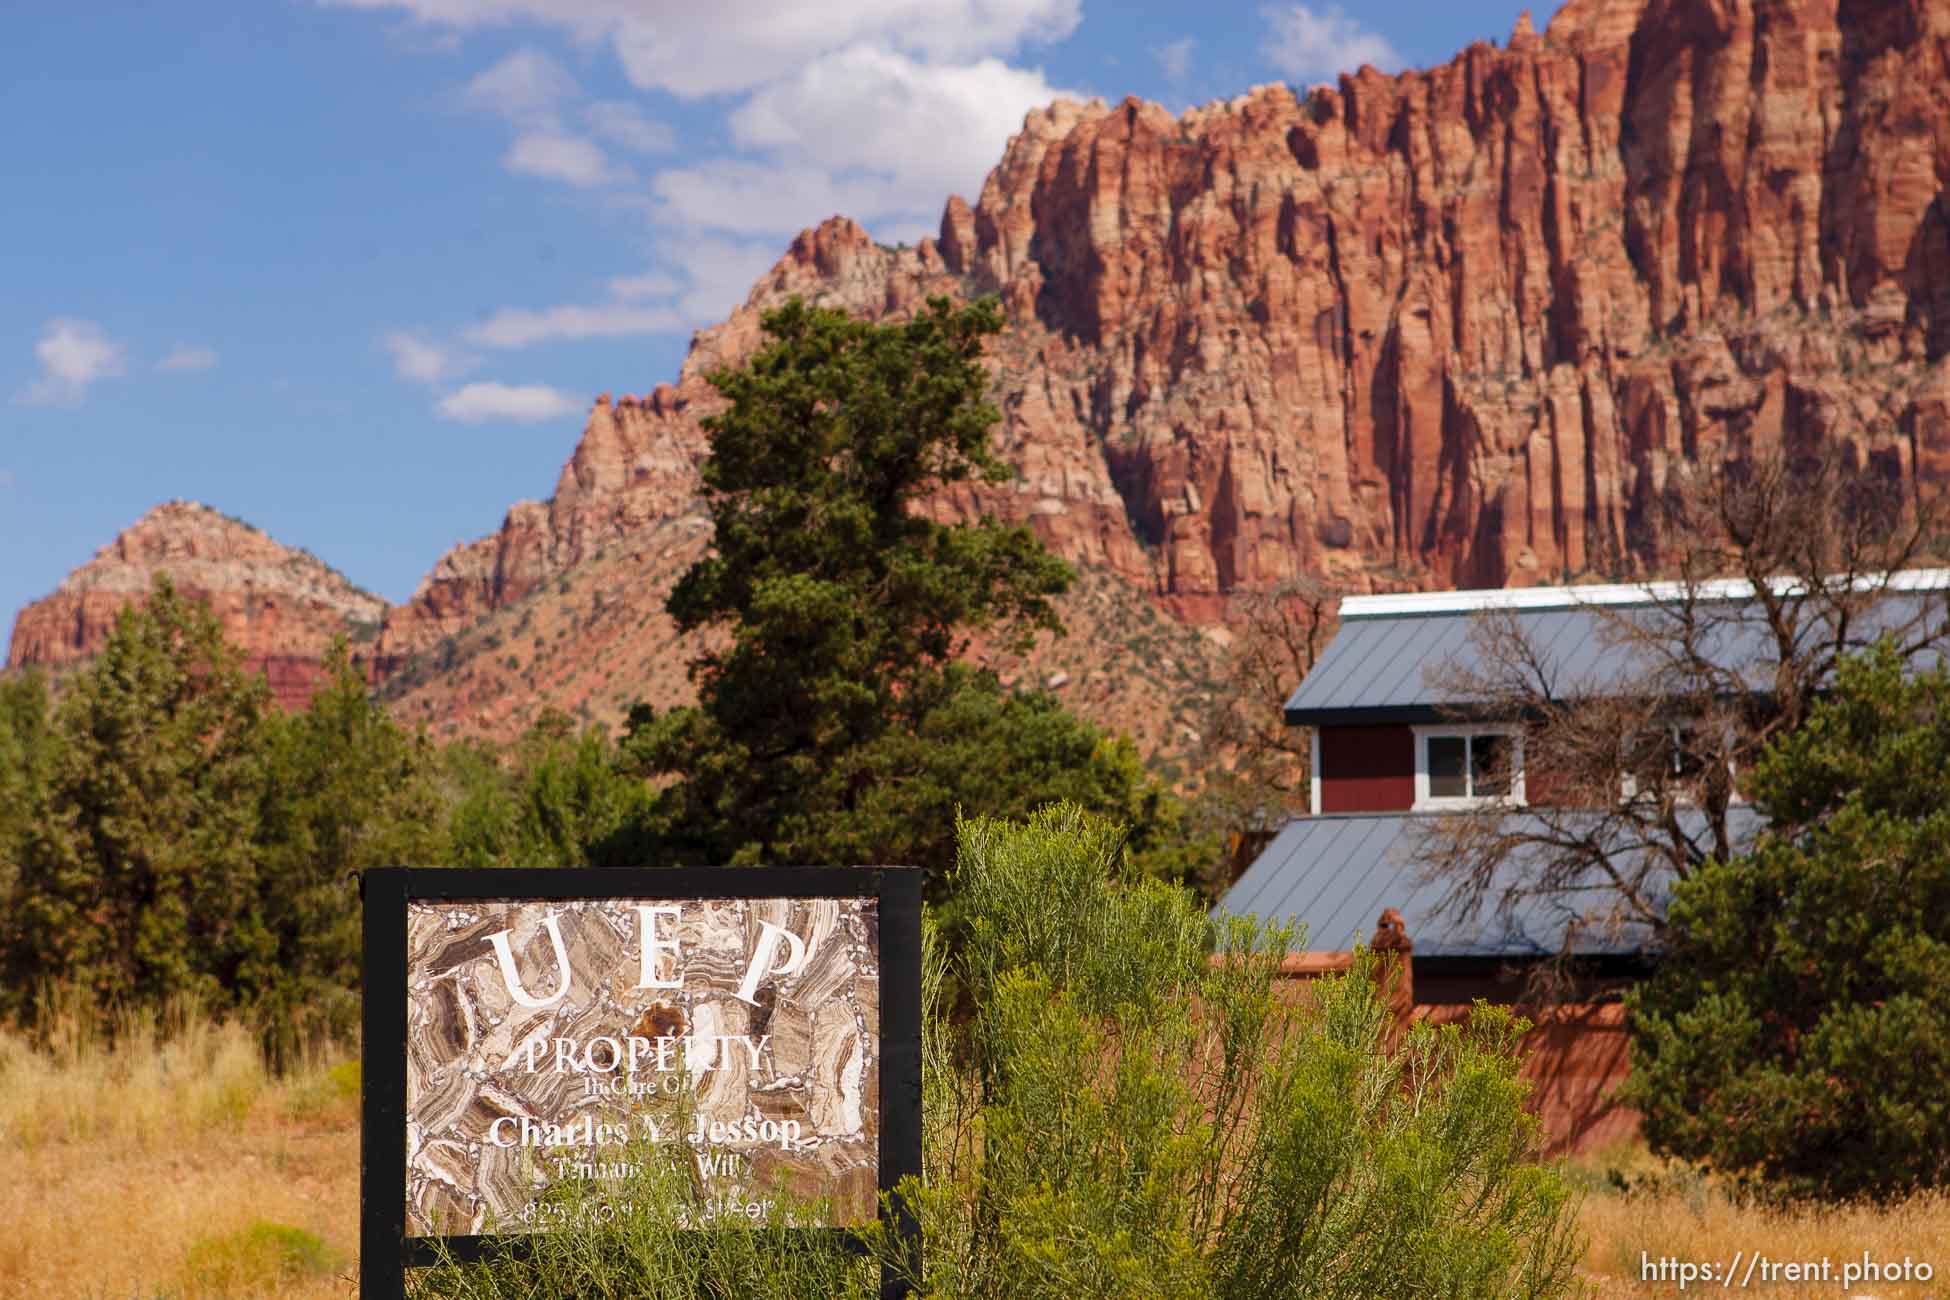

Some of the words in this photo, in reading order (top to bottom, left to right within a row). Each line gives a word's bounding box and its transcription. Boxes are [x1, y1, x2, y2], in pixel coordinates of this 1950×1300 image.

[489, 1114, 629, 1149] Charles
[687, 1112, 802, 1151] Jessop
[695, 1149, 742, 1180] Will
